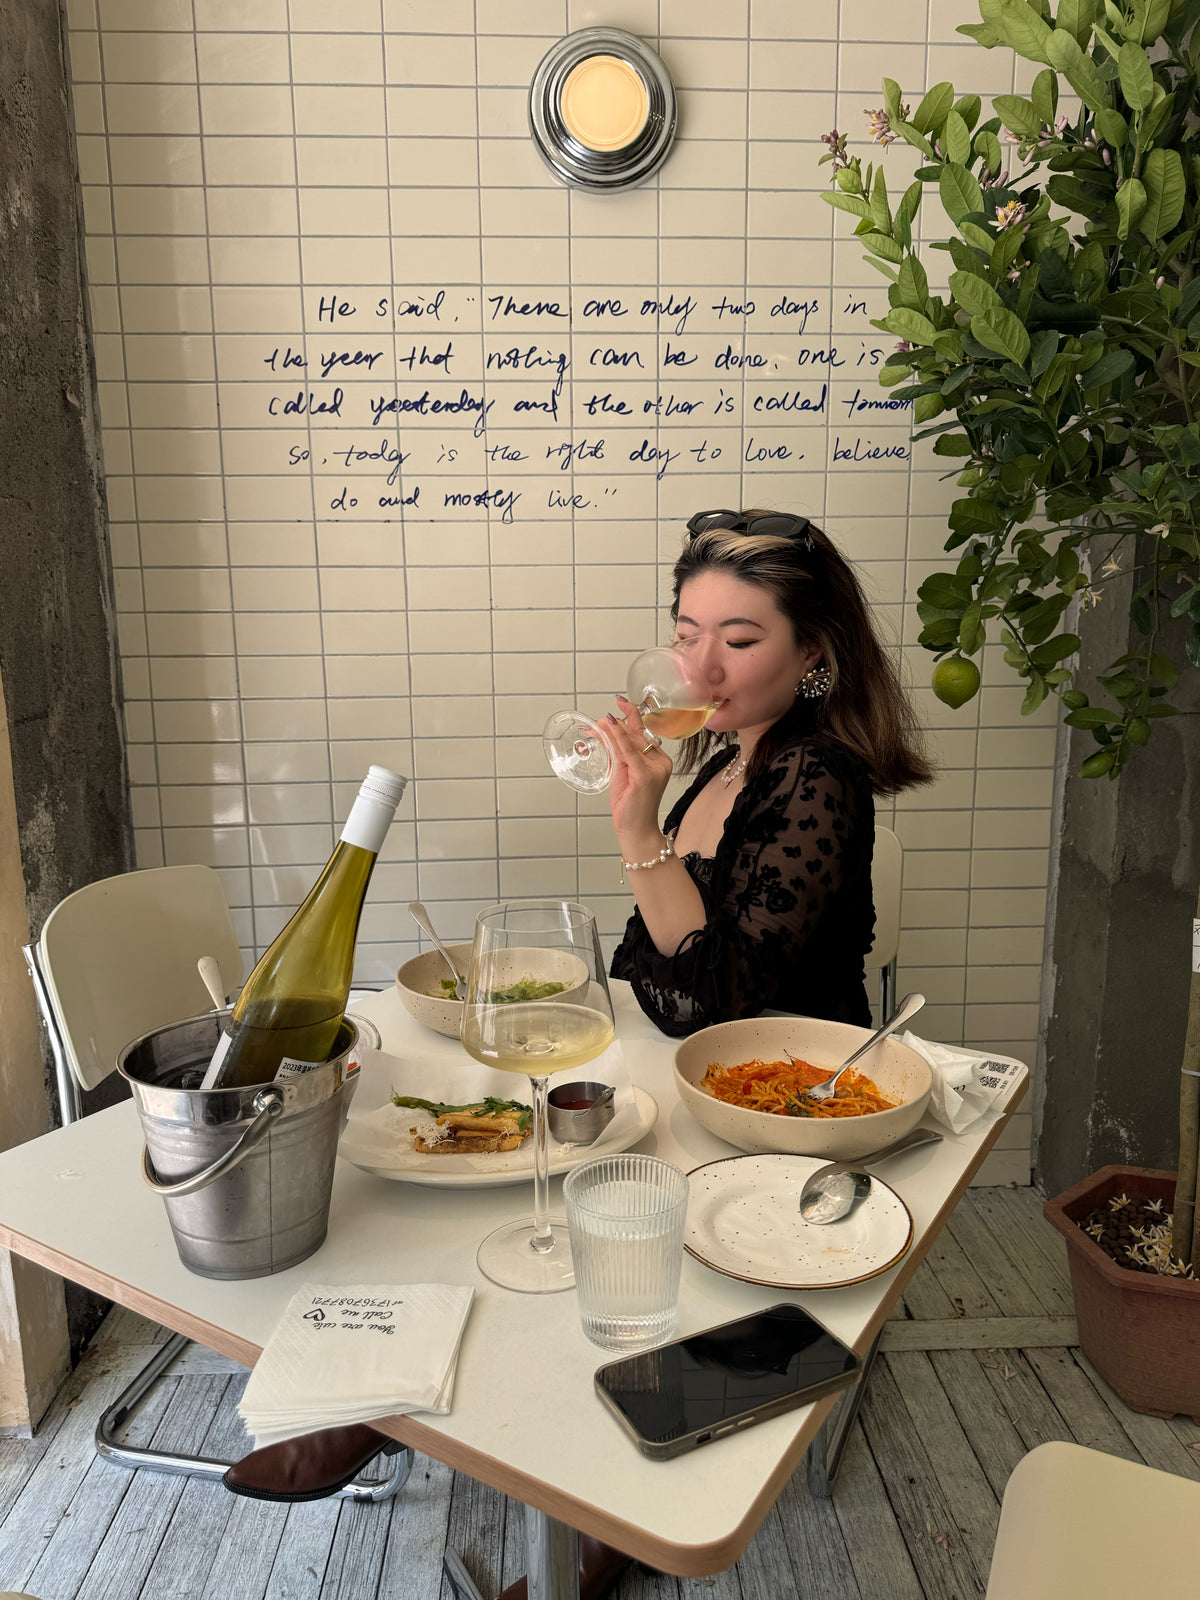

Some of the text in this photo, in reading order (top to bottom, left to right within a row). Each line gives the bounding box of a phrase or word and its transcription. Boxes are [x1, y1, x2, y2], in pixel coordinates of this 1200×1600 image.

[318, 295, 357, 323] He
[583, 300, 629, 318] are
[639, 294, 697, 336] only
[711, 297, 756, 320] two
[770, 296, 819, 336] days
[844, 294, 868, 316] in
[263, 348, 308, 371] the
[320, 350, 384, 378] year
[399, 342, 455, 374] that
[486, 346, 571, 396] nothing
[589, 348, 645, 369] can
[663, 343, 698, 367] be
[798, 350, 846, 368] one
[856, 342, 885, 367] is
[268, 388, 344, 418] called
[513, 389, 558, 422] and
[583, 393, 633, 416] the
[643, 394, 704, 416] other
[714, 388, 735, 415] is
[753, 383, 827, 414] called
[333, 439, 412, 485] today
[437, 444, 459, 467] is
[485, 444, 530, 462] the
[545, 439, 605, 471] right
[629, 440, 681, 481] day
[690, 440, 722, 463] to
[330, 486, 359, 511] do
[378, 486, 420, 508] and
[443, 489, 523, 525] mostly
[312, 1322, 396, 1335] You are cute
[340, 1308, 393, 1320] Call me
